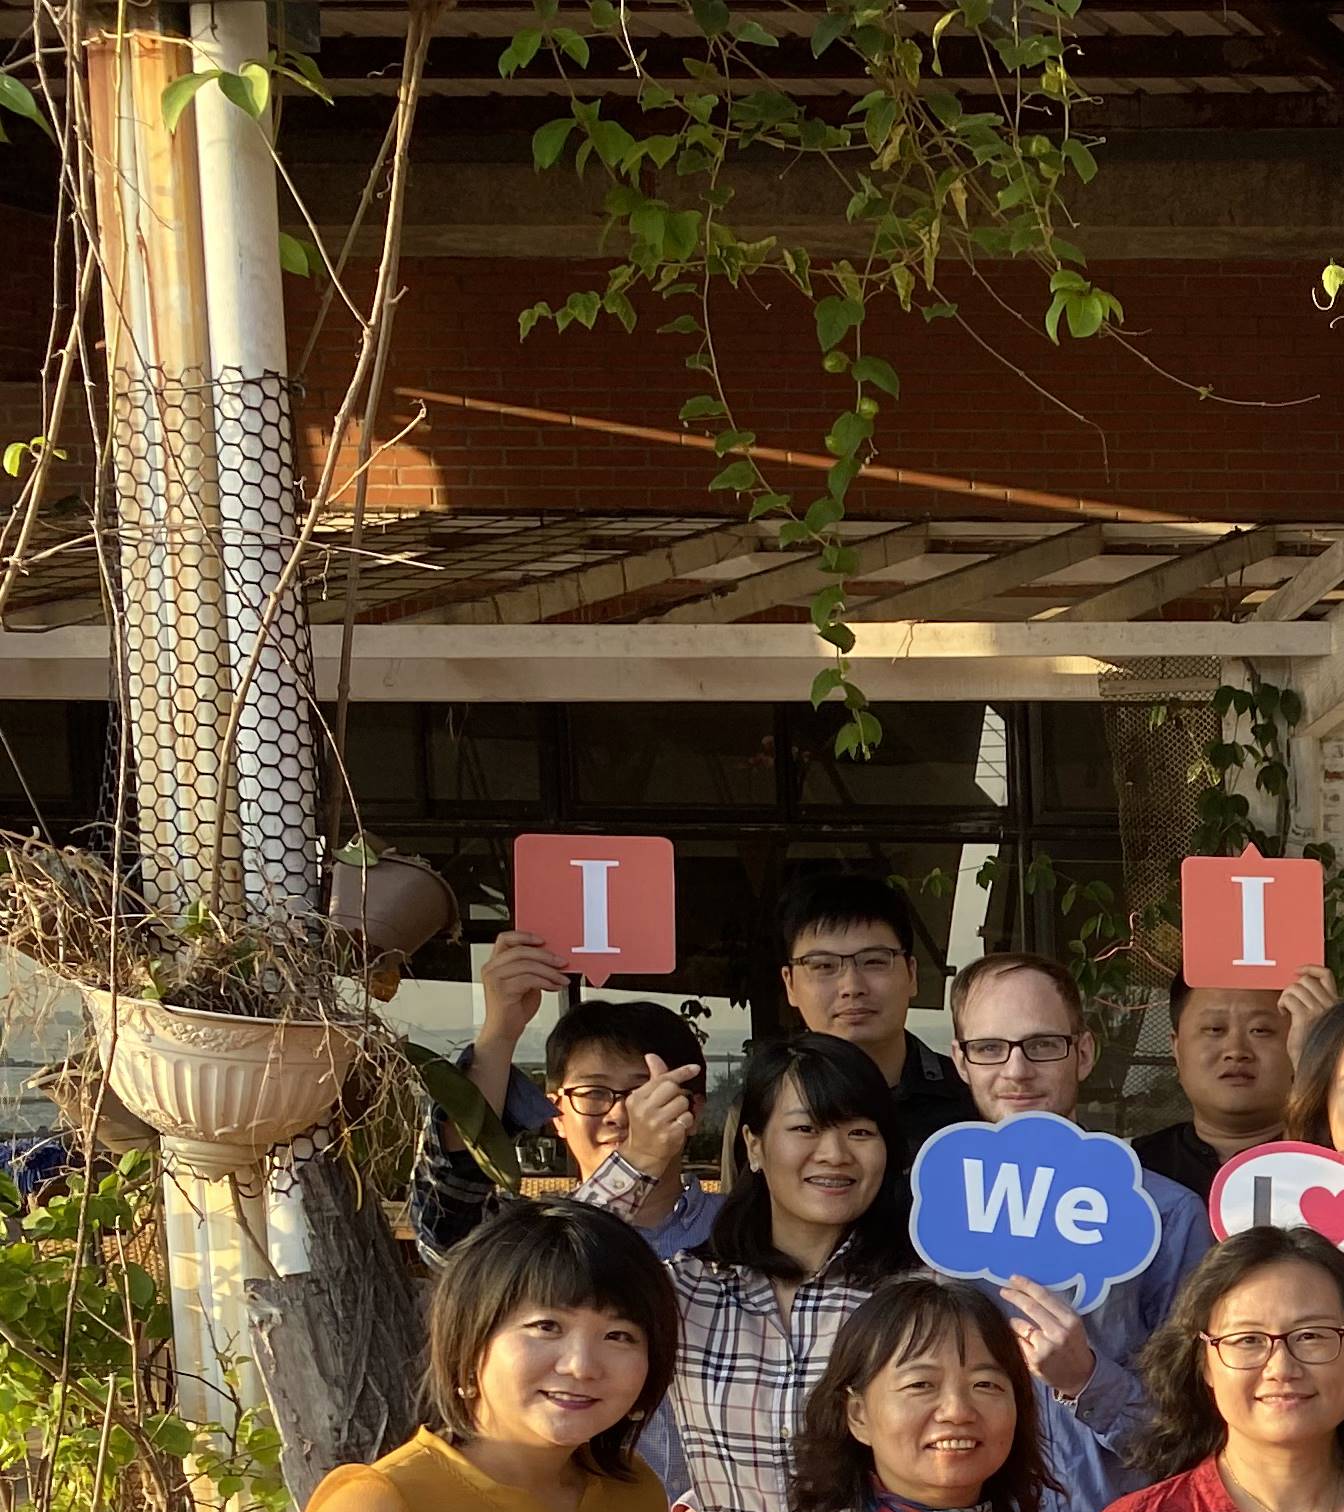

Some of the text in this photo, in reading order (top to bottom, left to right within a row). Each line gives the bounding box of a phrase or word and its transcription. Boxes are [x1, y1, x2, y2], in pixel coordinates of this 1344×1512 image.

[570, 859, 621, 954] I
[1230, 875, 1277, 967] I
[962, 1156, 1110, 1245] We
